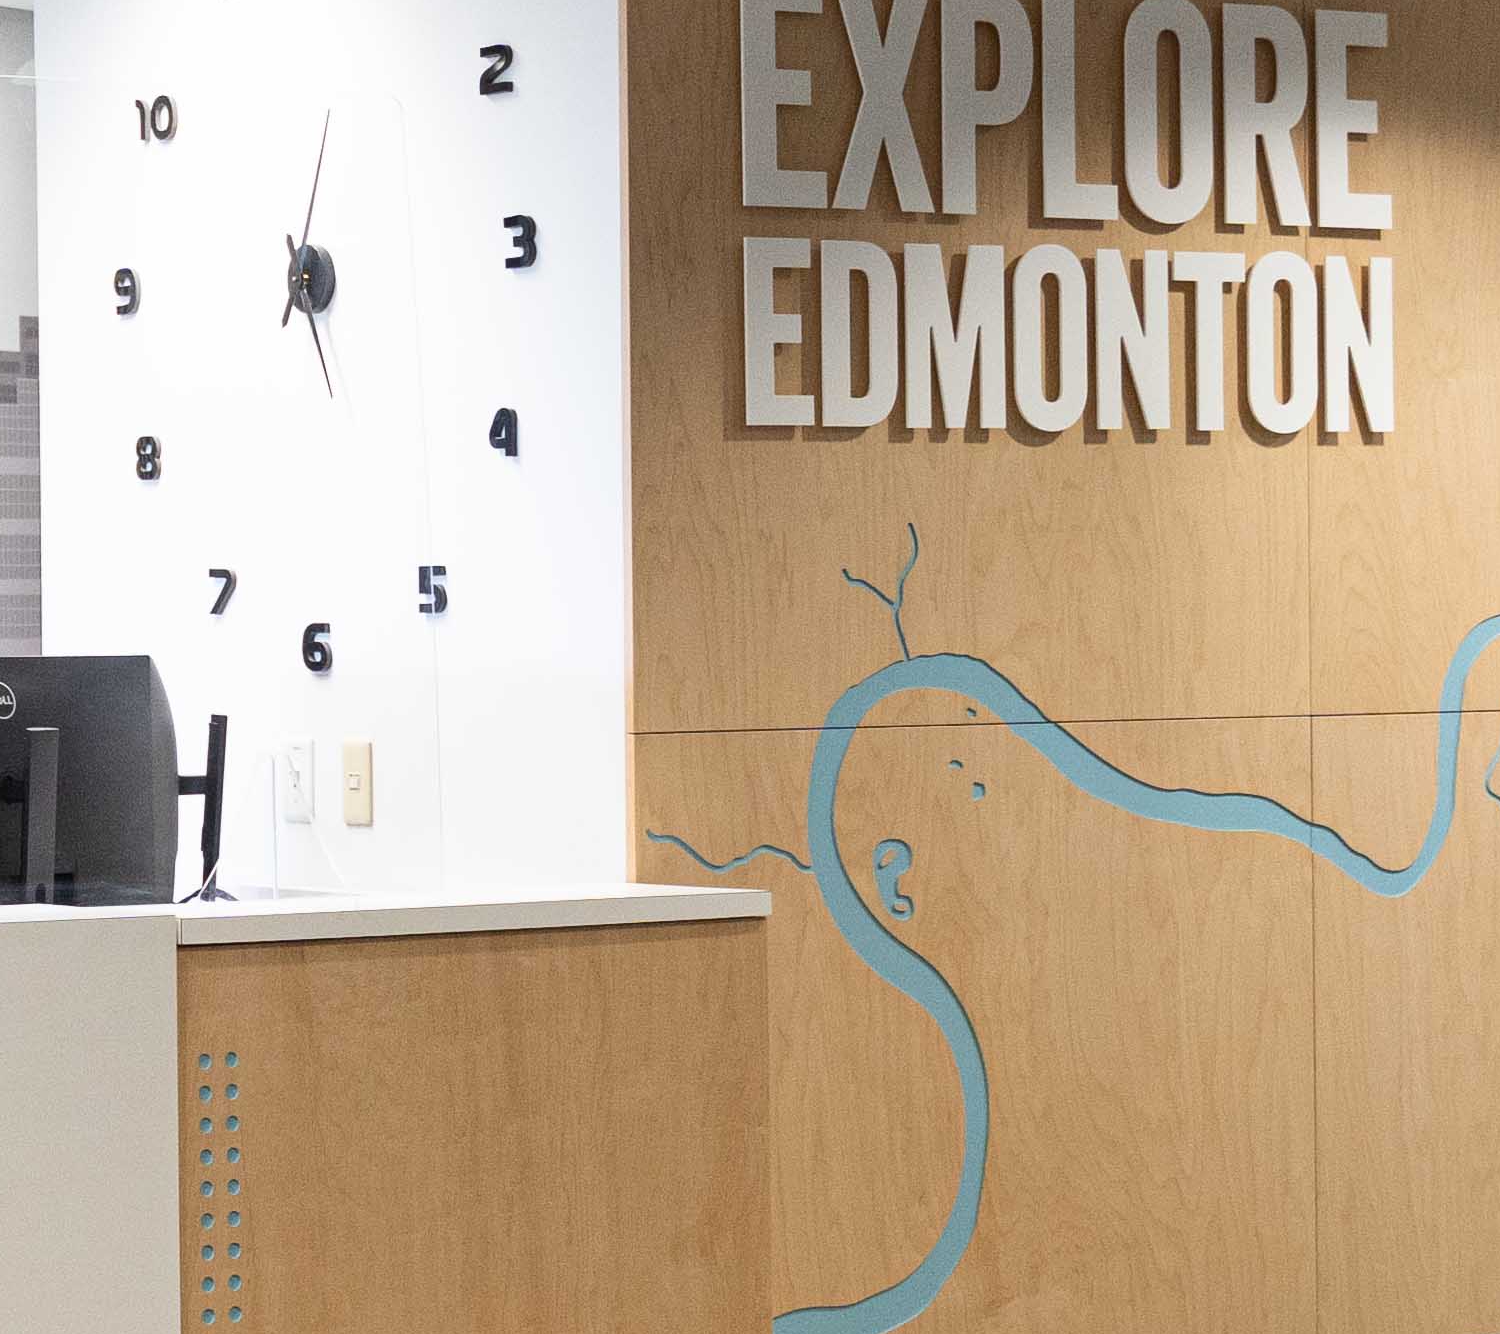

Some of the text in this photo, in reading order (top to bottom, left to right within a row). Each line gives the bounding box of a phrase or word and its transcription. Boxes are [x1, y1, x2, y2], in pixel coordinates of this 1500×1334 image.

[479, 44, 514, 96] 2
[135, 95, 178, 141] 10
[503, 214, 538, 269] 3
[114, 267, 140, 315] 9
[743, 237, 1395, 434] EDMONTON
[488, 407, 519, 457] 4
[135, 436, 162, 481] 8
[208, 568, 237, 615] 7
[418, 565, 448, 614] 5
[302, 622, 333, 673] 6
